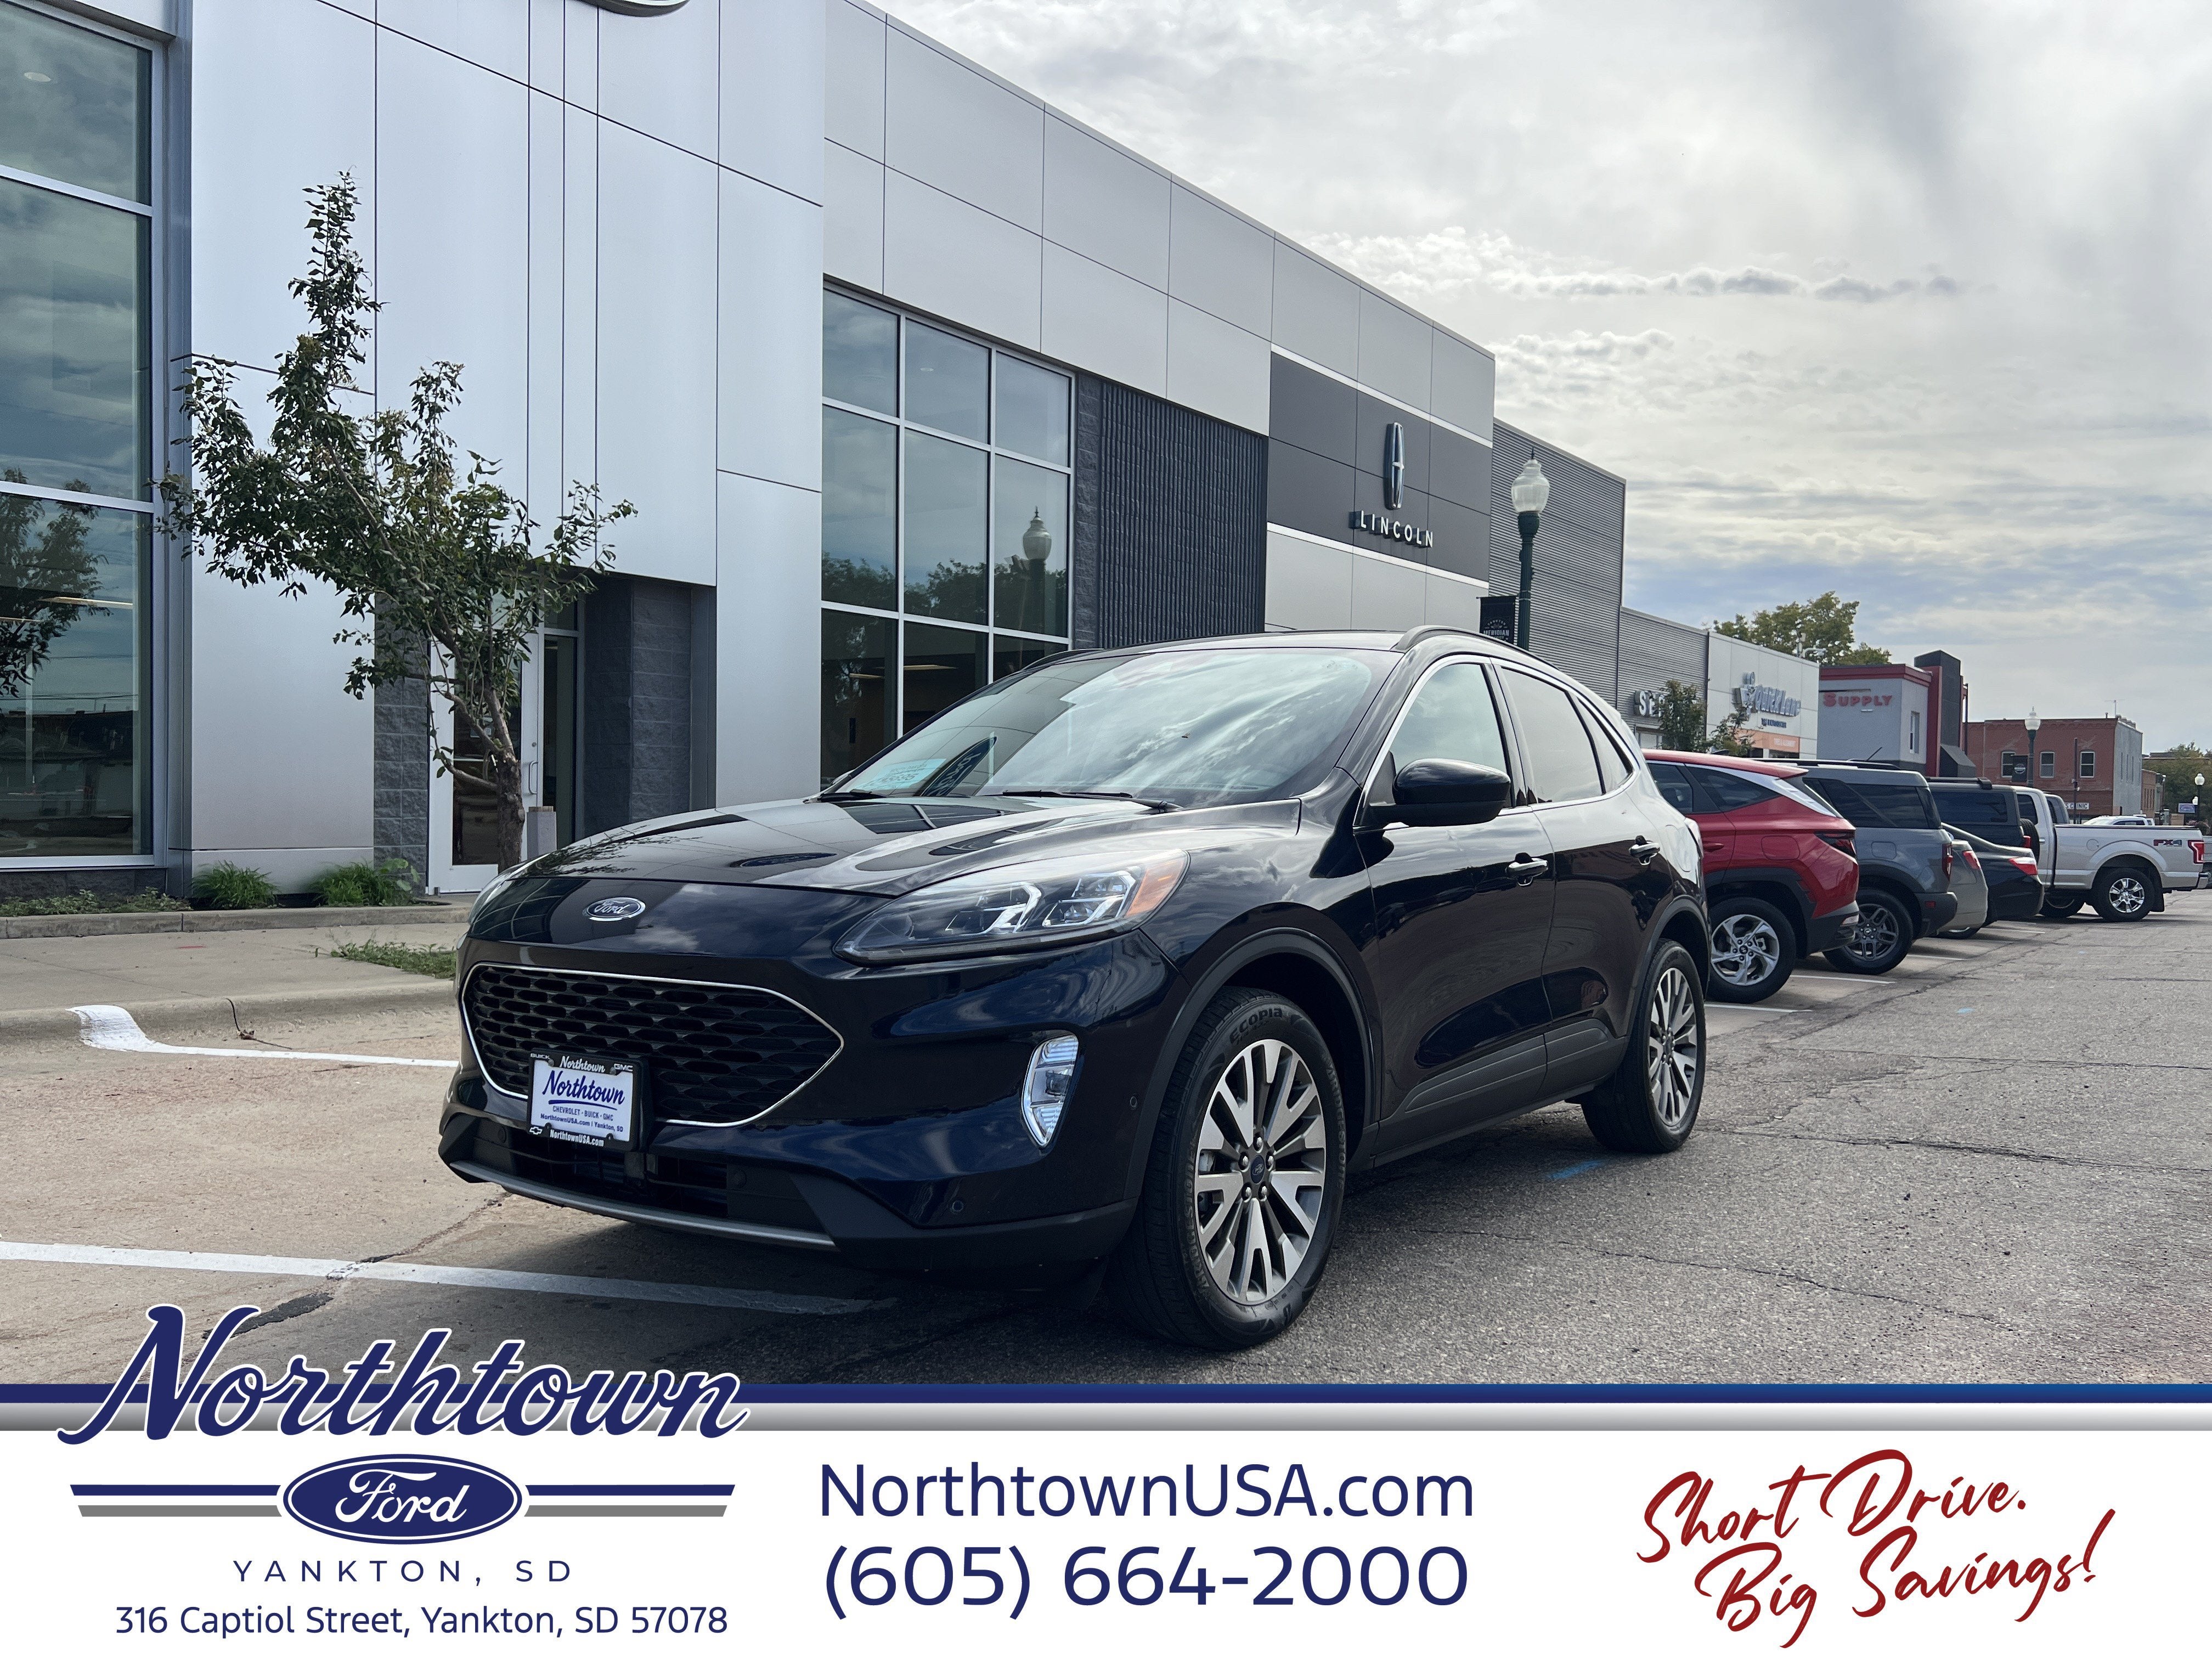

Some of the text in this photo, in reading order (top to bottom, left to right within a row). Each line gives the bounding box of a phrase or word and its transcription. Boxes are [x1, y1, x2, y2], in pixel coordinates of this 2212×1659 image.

[1360, 510, 1433, 548] LINCOLN
[594, 900, 630, 915] Ford
[560, 1056, 606, 1073] Northtown
[613, 1063, 633, 1072] GMC
[542, 1070, 625, 1105] Northtown
[552, 1105, 580, 1115] CHEVROLET
[603, 1113, 613, 1121] GMC
[540, 1113, 590, 1126] NorthtownUSA.com
[594, 1121, 616, 1132] Yankton,
[550, 1128, 604, 1147] NorthtownUSA.com
